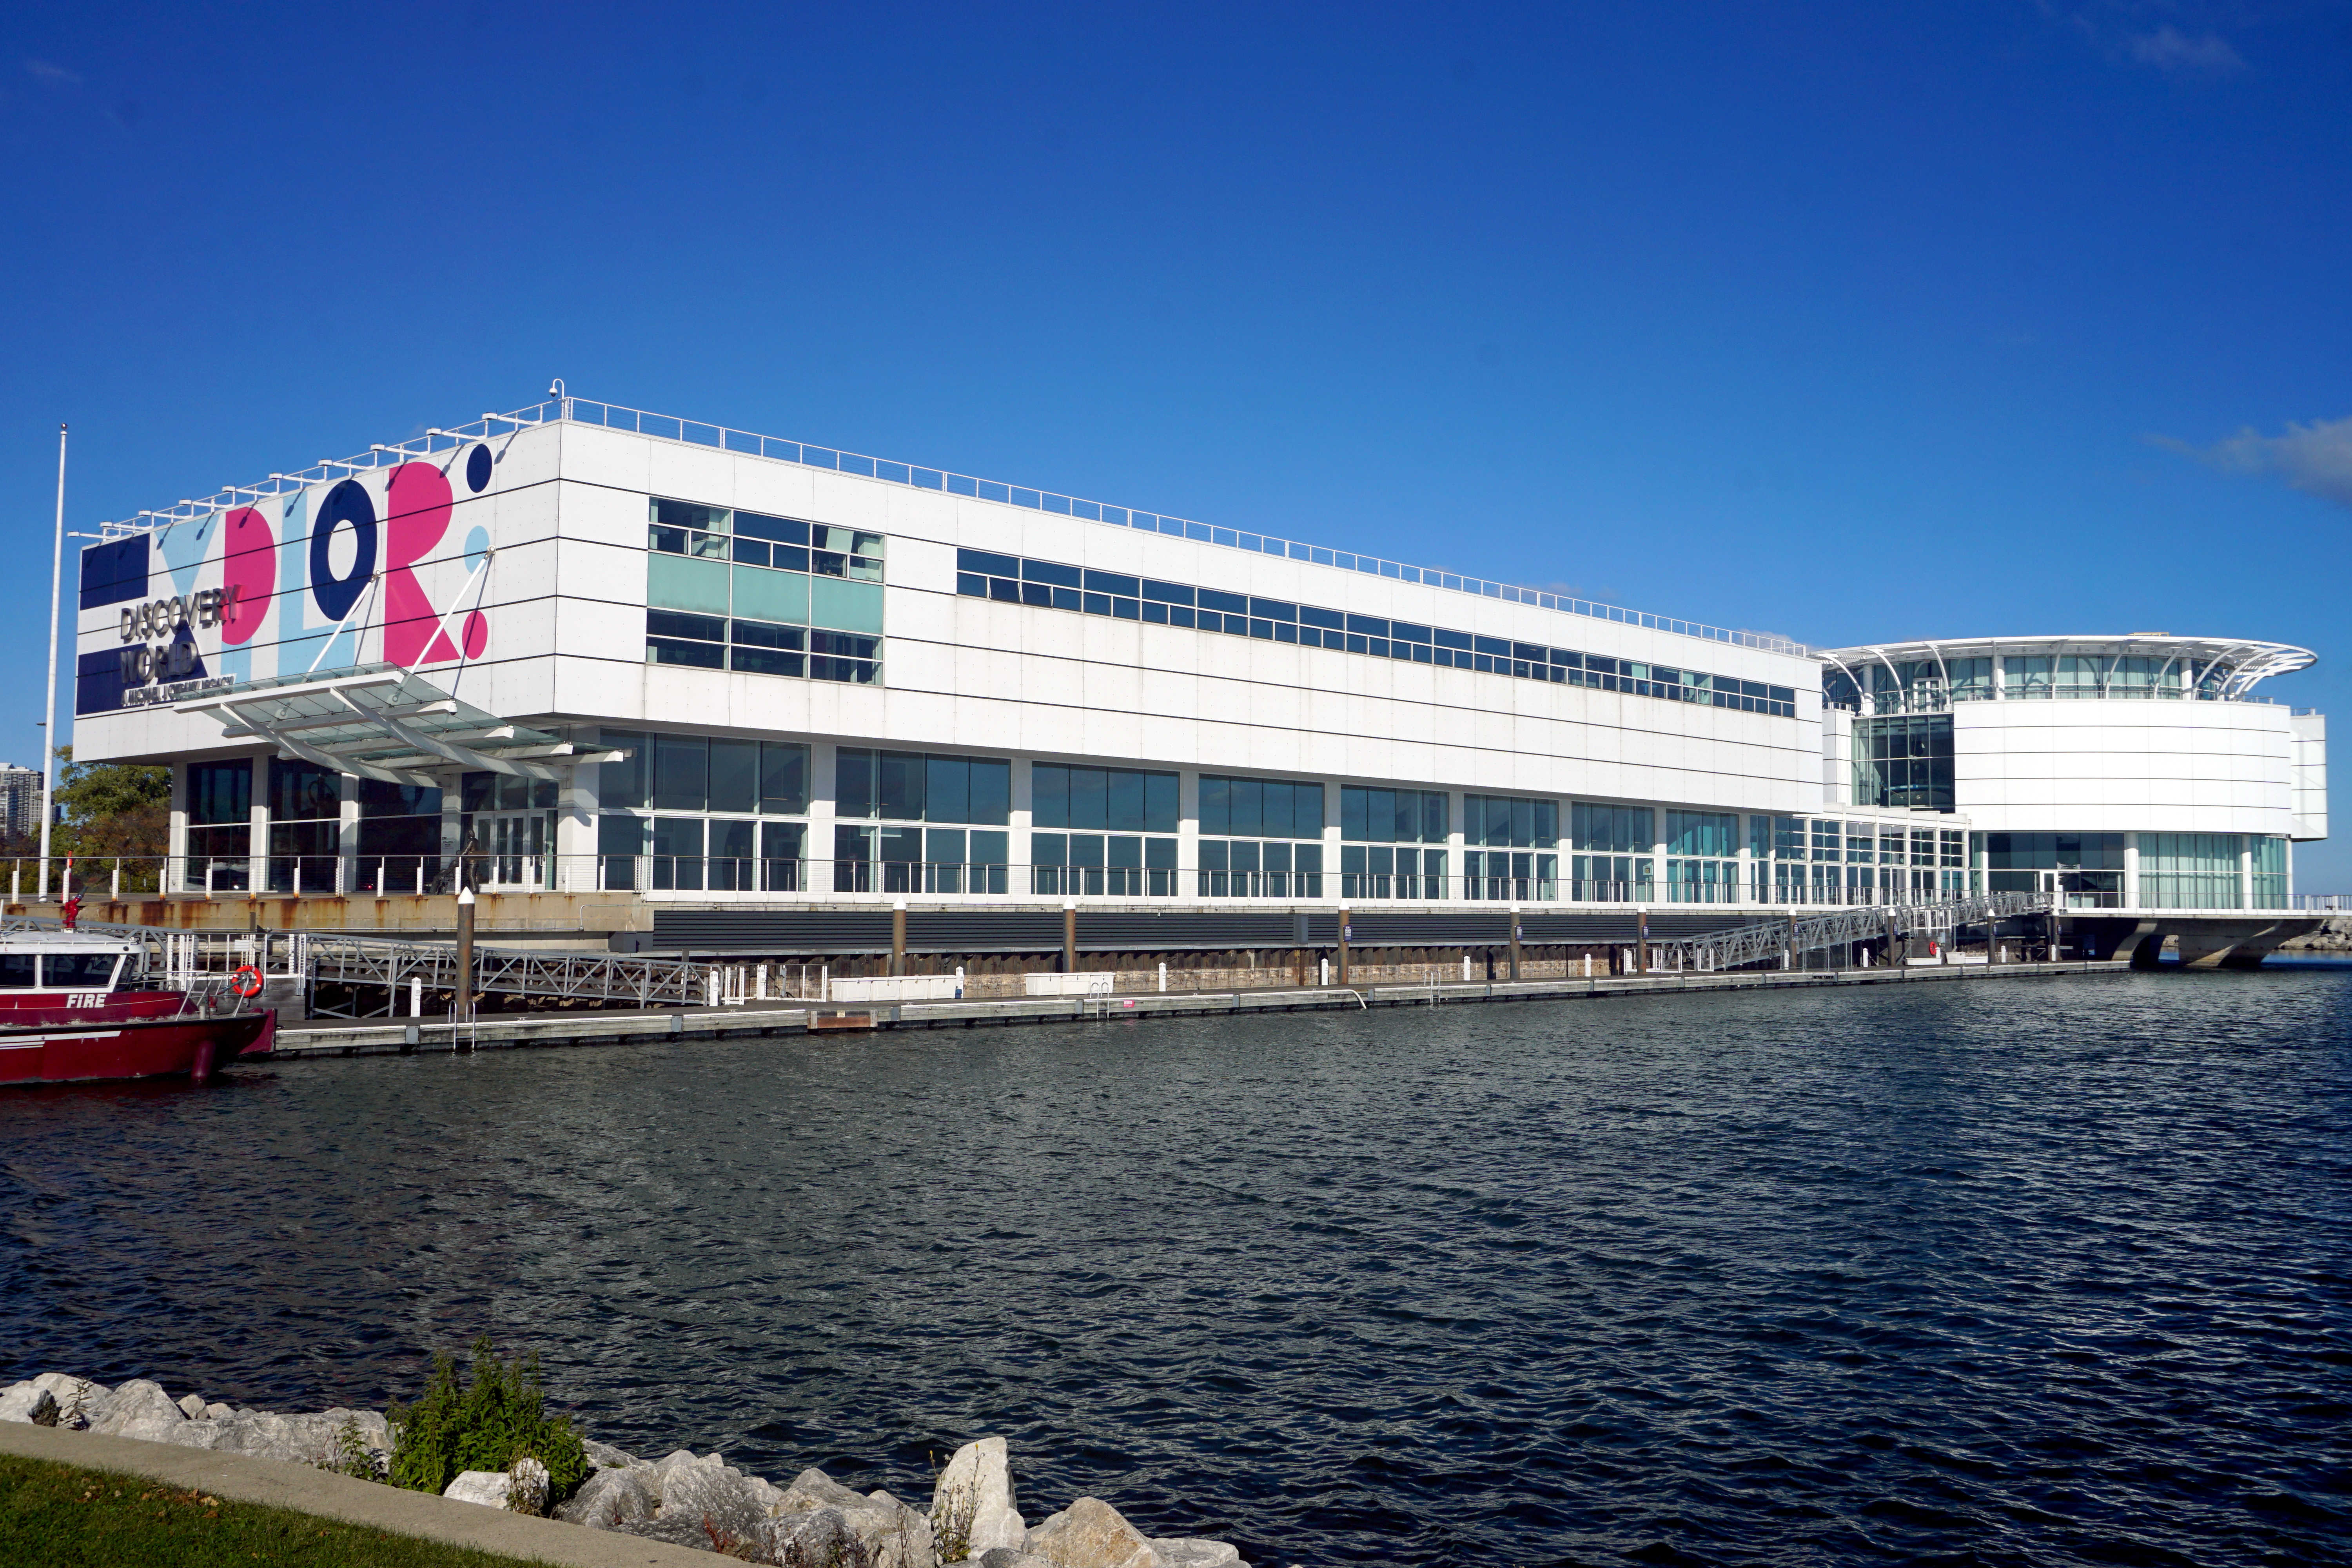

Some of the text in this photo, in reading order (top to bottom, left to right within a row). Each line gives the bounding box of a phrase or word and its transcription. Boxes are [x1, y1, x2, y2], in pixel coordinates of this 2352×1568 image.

[120, 584, 241, 639] DISCOVERY
[121, 641, 198, 683] WORLD
[66, 994, 107, 1008] FIRE
